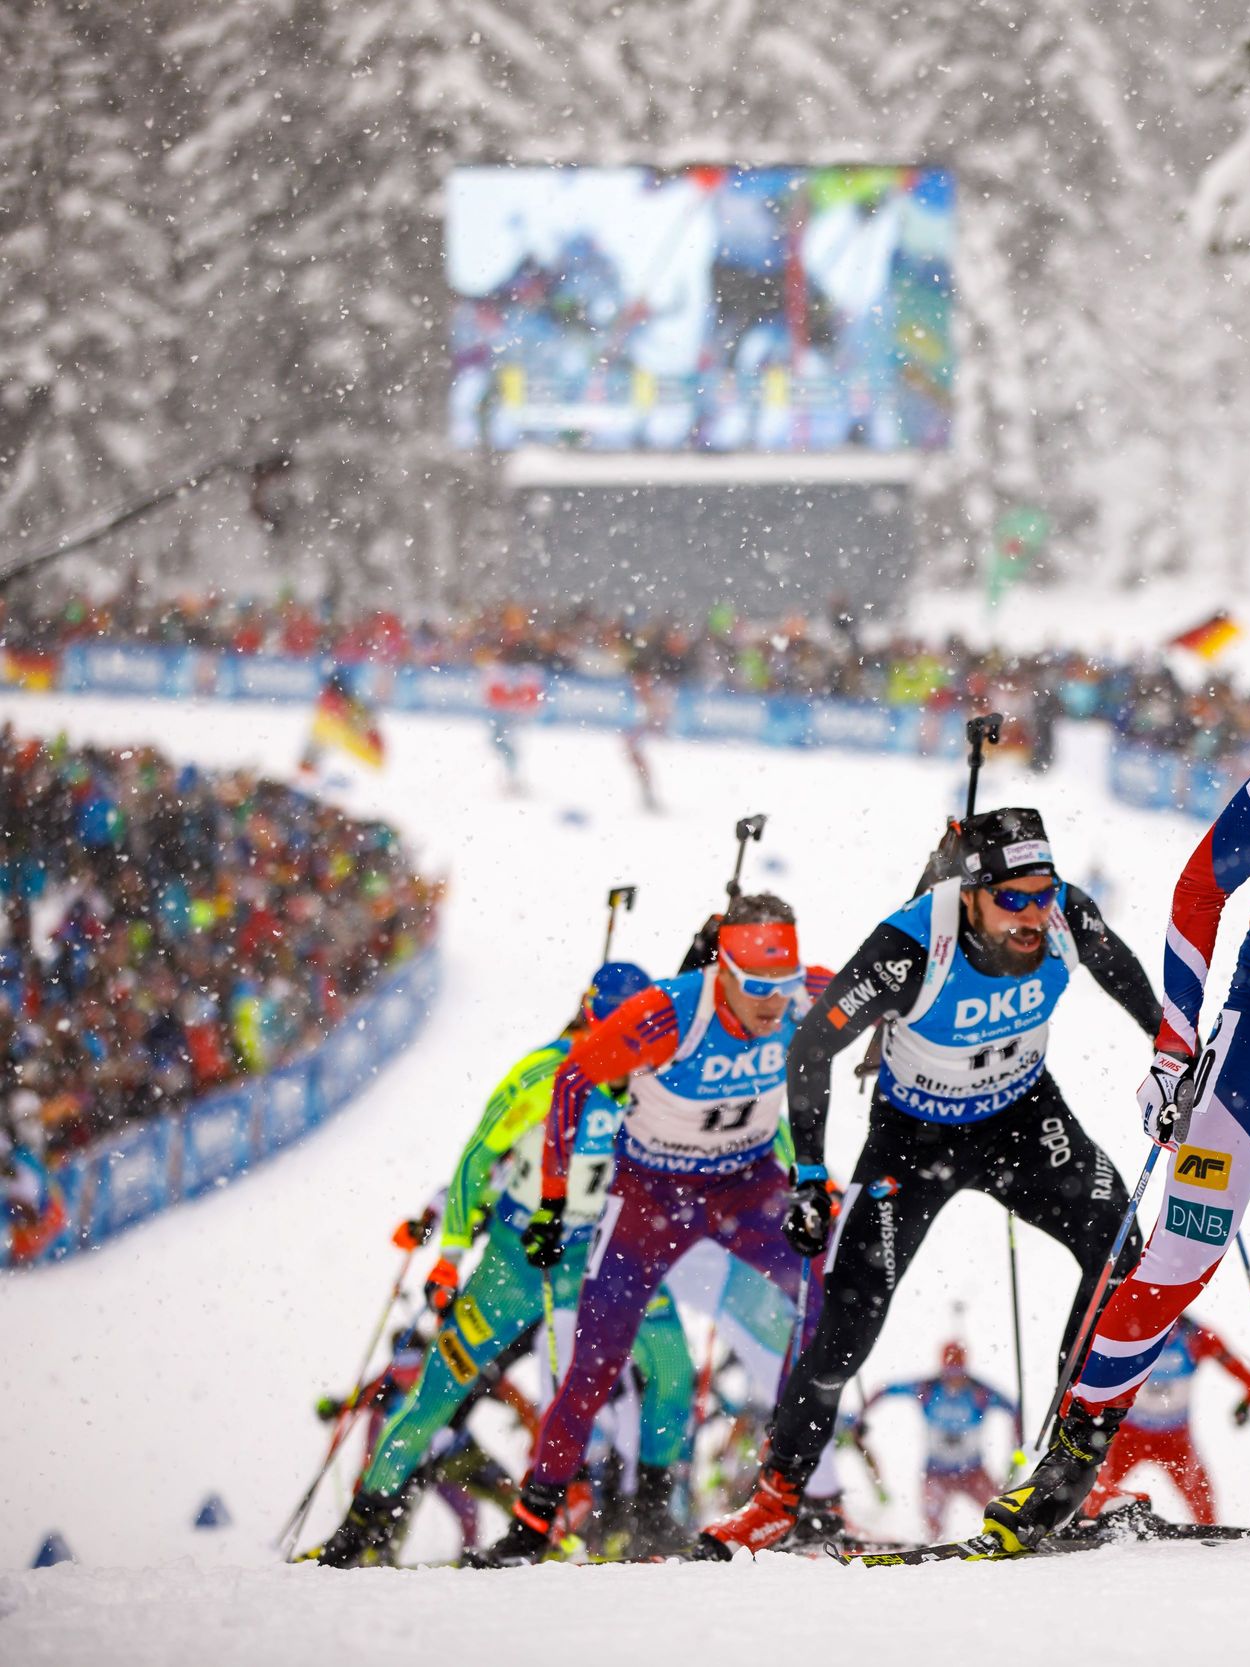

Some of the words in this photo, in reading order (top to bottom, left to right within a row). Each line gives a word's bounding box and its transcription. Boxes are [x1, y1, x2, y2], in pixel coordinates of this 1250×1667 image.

[838, 977, 878, 1018] BKW
[954, 978, 1046, 1029] DKB
[701, 1041, 785, 1082] DKB
[892, 1083, 966, 1117] BMW
[1172, 1204, 1224, 1238] DNB
[877, 1201, 899, 1290] swisscom
